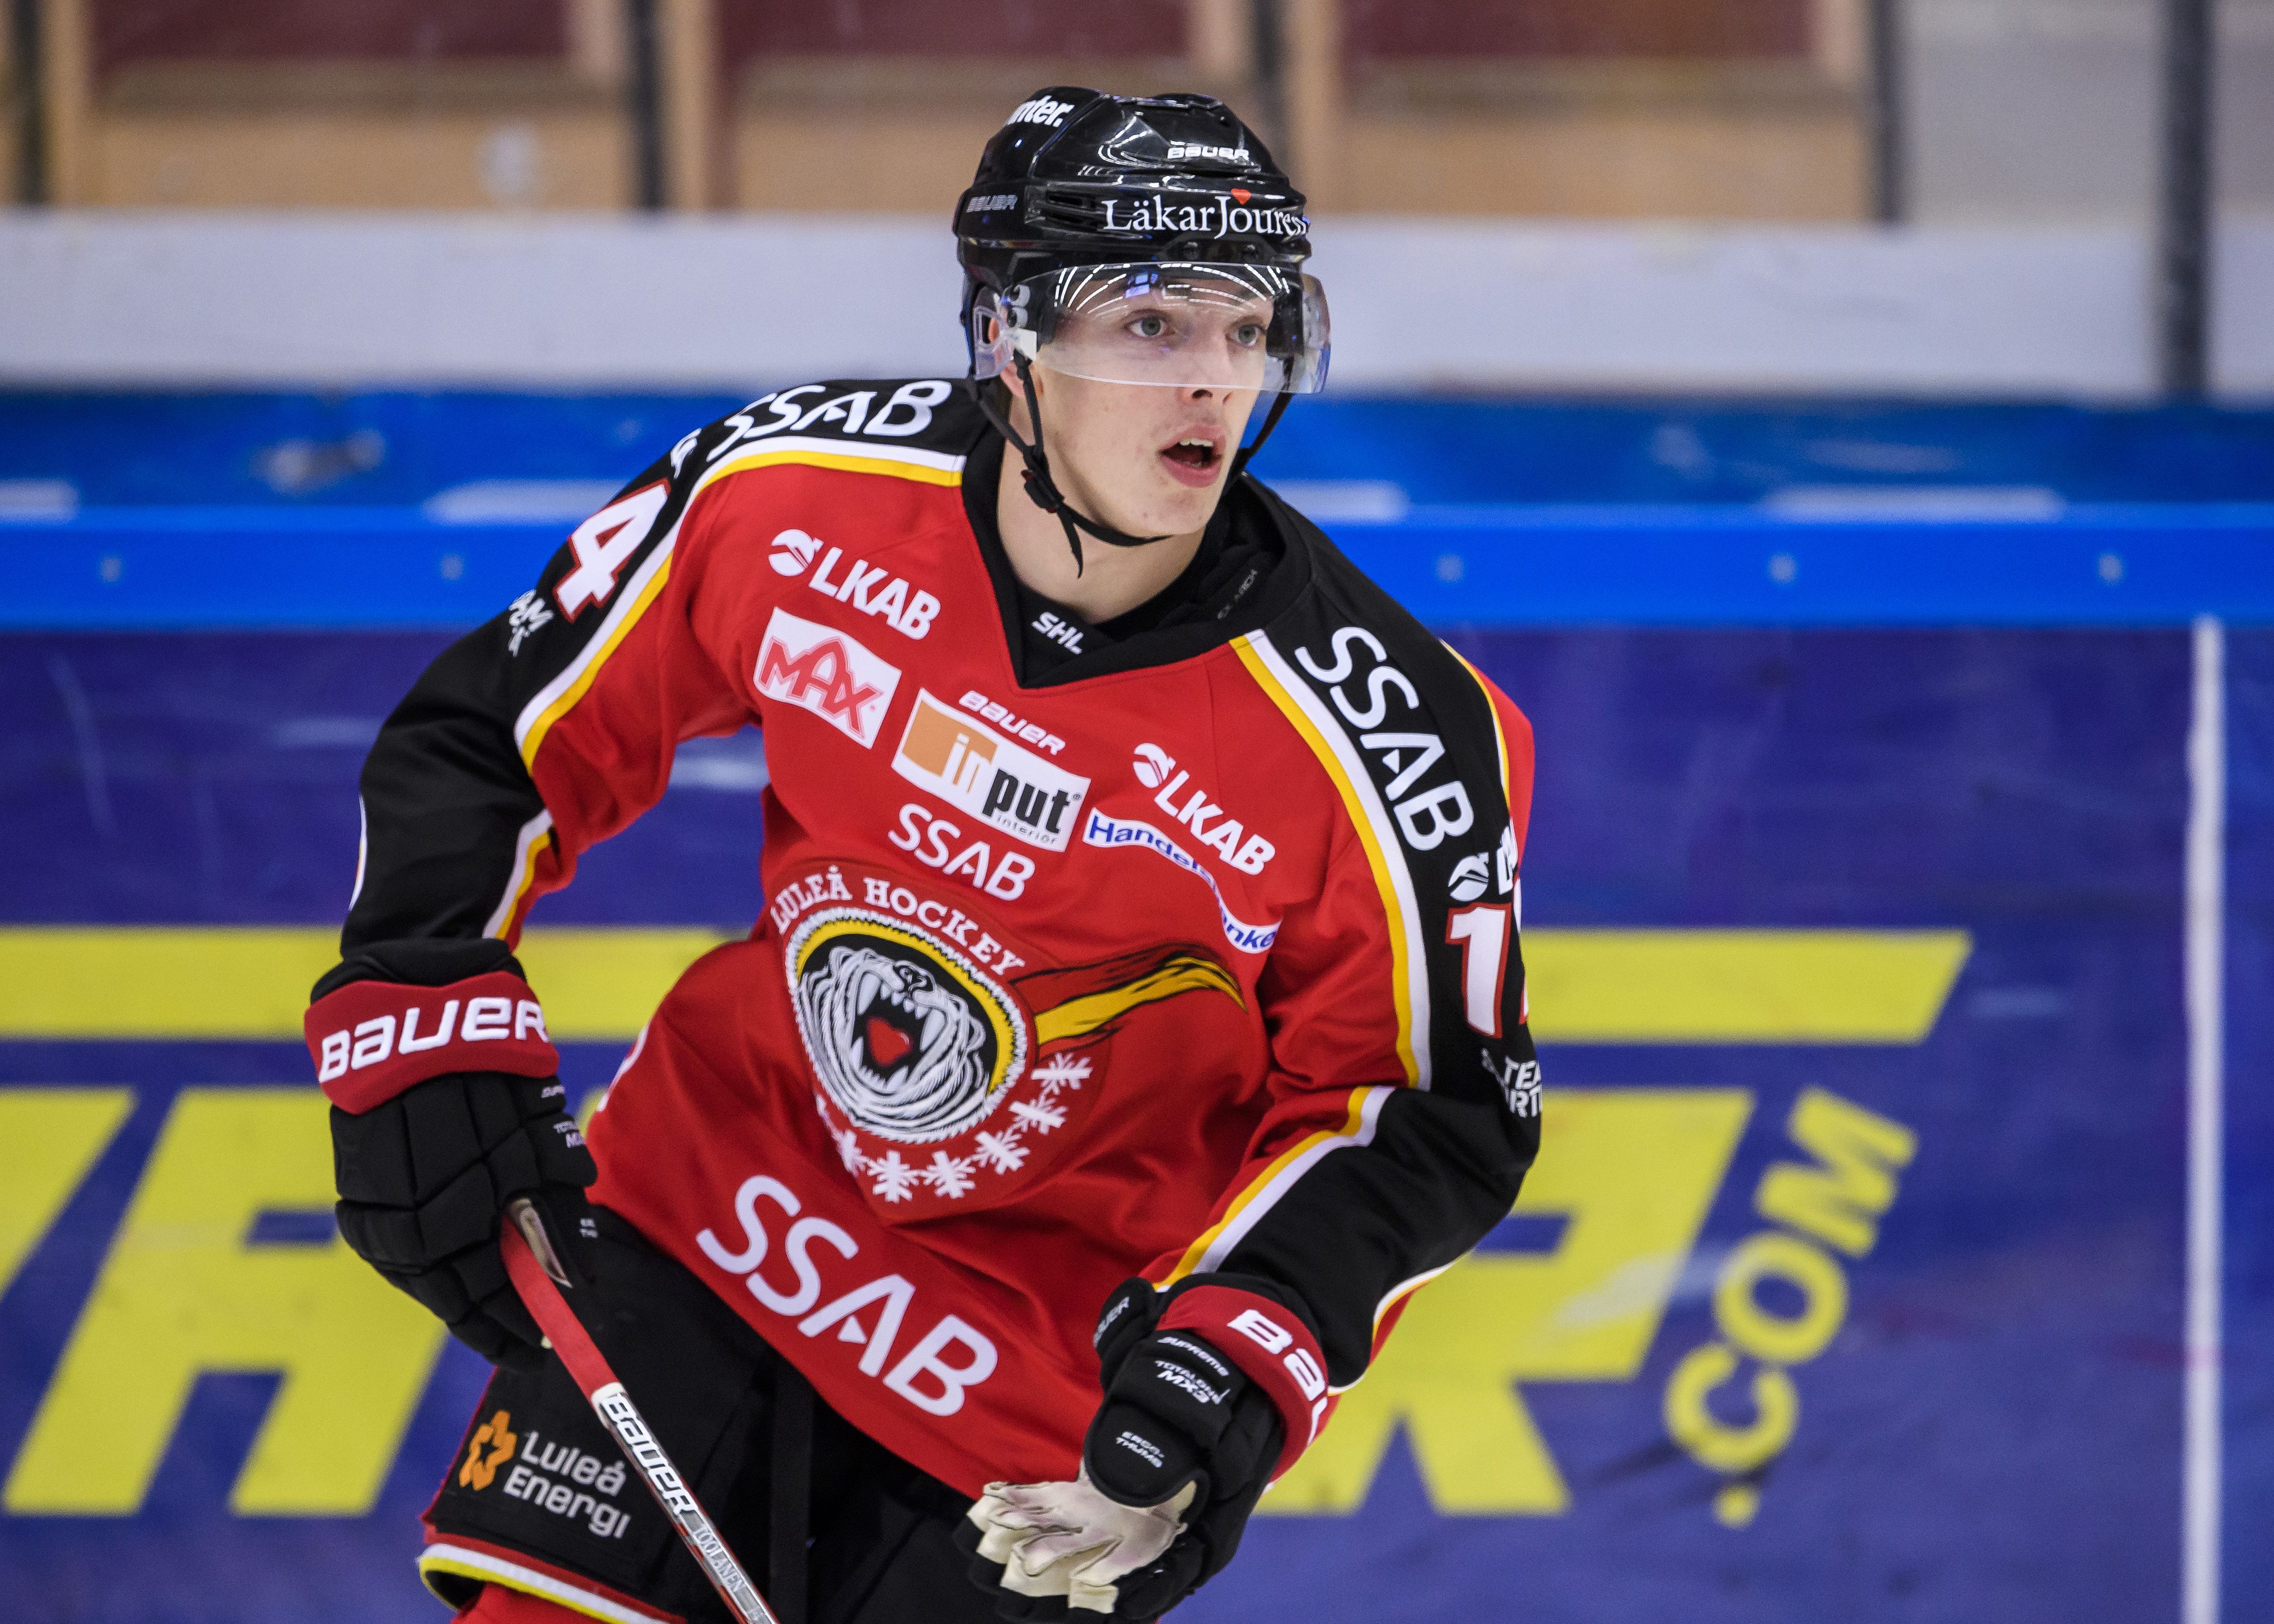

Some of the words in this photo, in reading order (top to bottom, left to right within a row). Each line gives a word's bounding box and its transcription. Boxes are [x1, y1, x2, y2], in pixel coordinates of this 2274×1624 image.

[706, 380, 953, 462] SSAB
[808, 547, 941, 640] LKAB
[1031, 611, 1083, 654] SHL
[760, 636, 883, 740] MAX
[1295, 626, 1474, 851] SSAB
[888, 803, 1036, 901] SSAB
[997, 814, 1057, 844] interior
[1153, 770, 1277, 876] LKAB
[771, 865, 853, 935] LULEÅ
[863, 877, 1026, 976] HOCKEY
[696, 1175, 998, 1417] SSAB
[503, 1466, 631, 1540] Energi
[520, 1430, 627, 1497] Luleå
